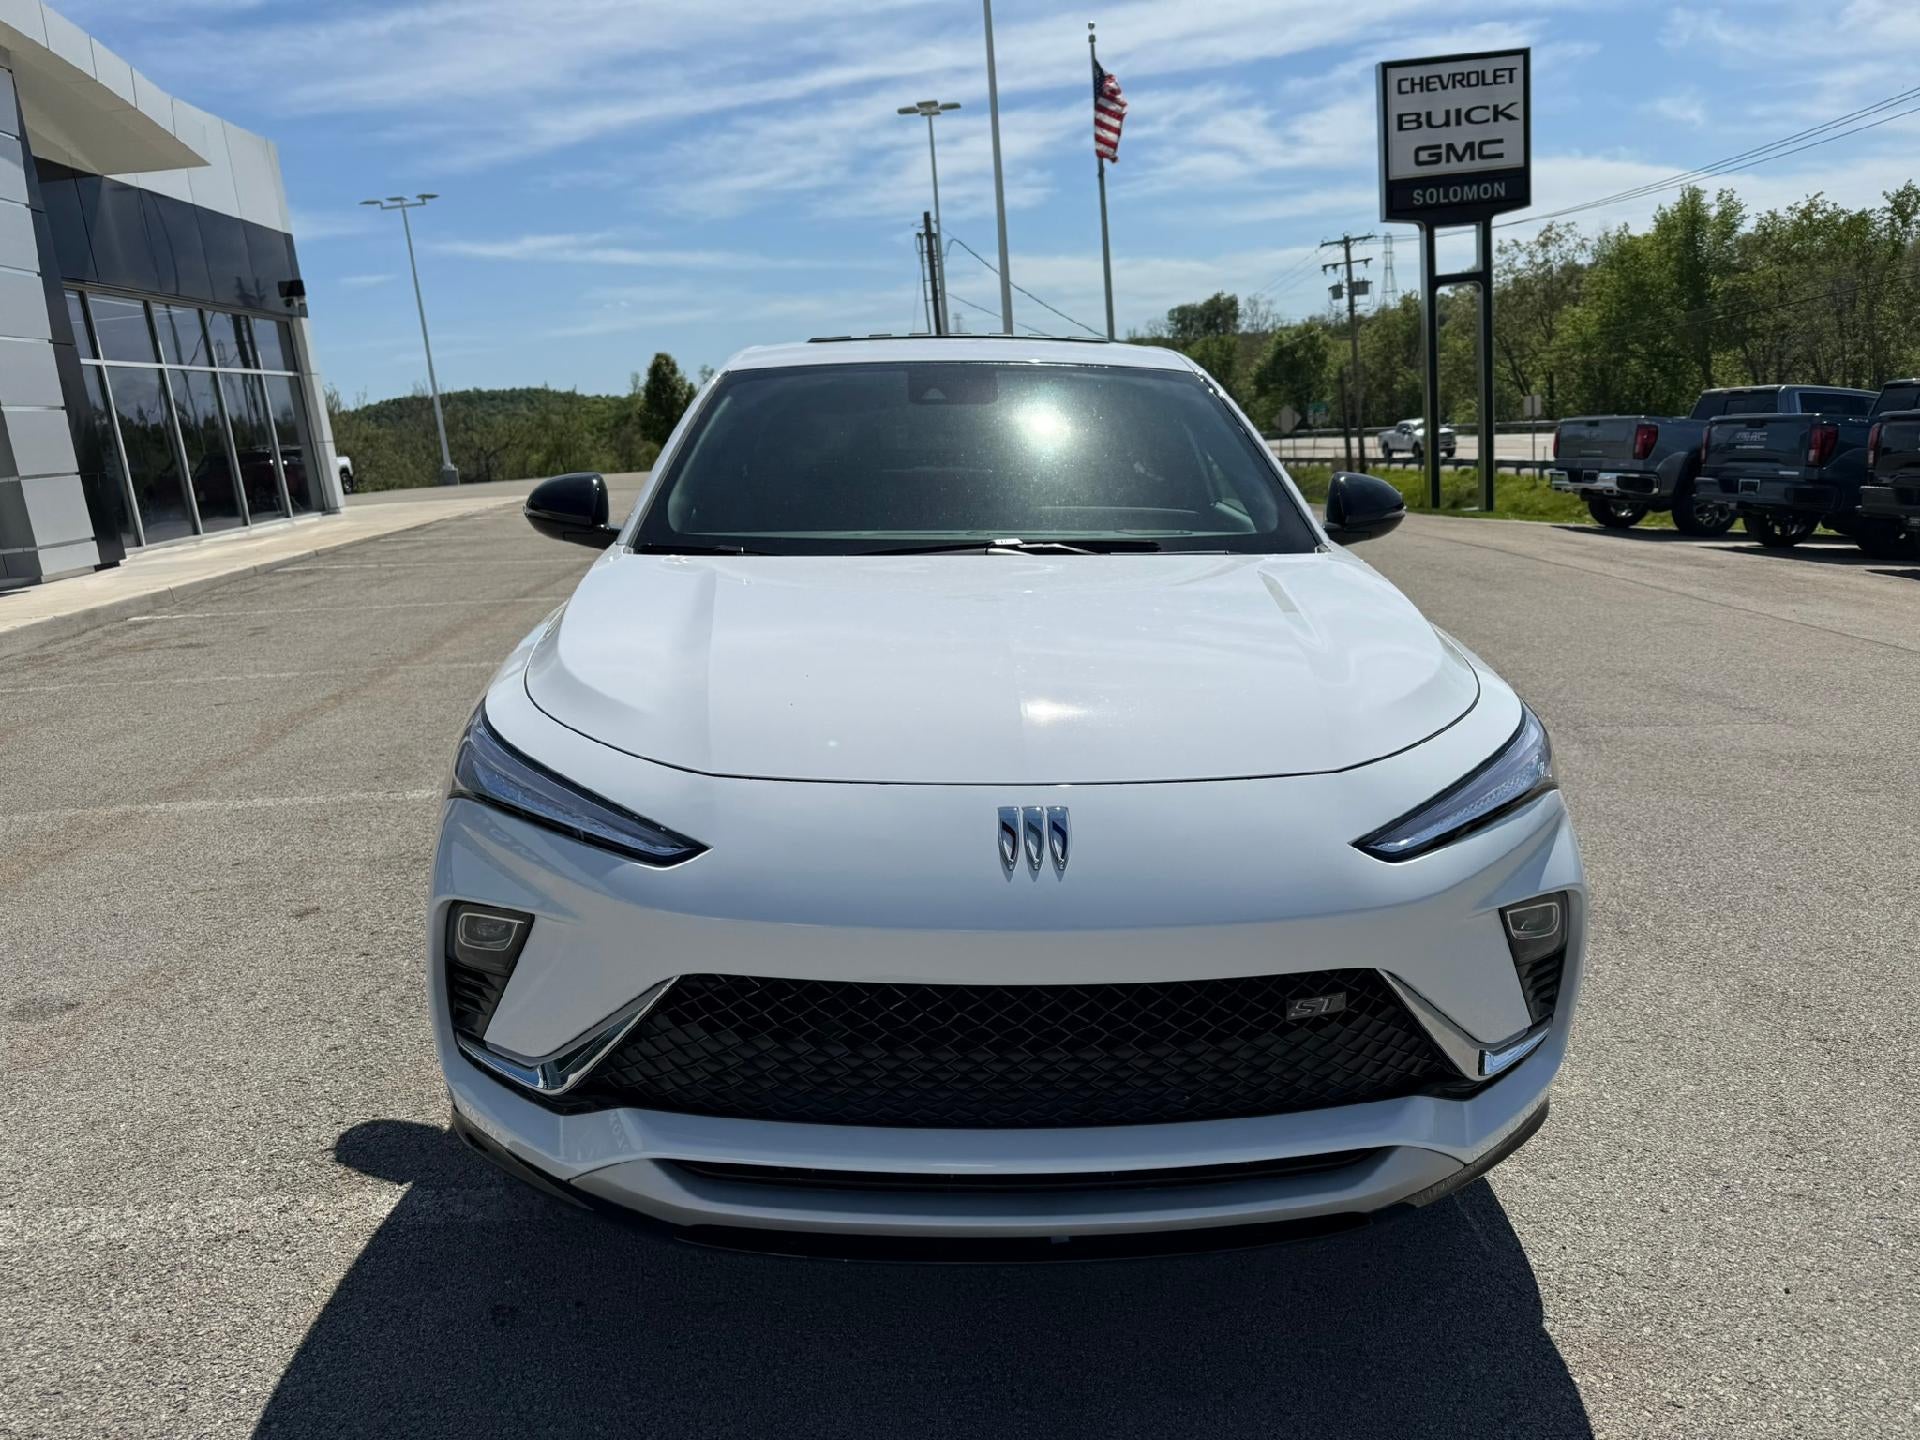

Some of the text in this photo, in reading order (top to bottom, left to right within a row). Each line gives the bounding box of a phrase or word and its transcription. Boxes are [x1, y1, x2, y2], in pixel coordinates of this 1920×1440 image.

[1397, 67, 1518, 95] CHEVROLET
[1397, 102, 1520, 131] BUICK
[1414, 138, 1504, 167] GMC
[1412, 181, 1506, 206] SOLOMON
[1290, 994, 1344, 1017] ST
